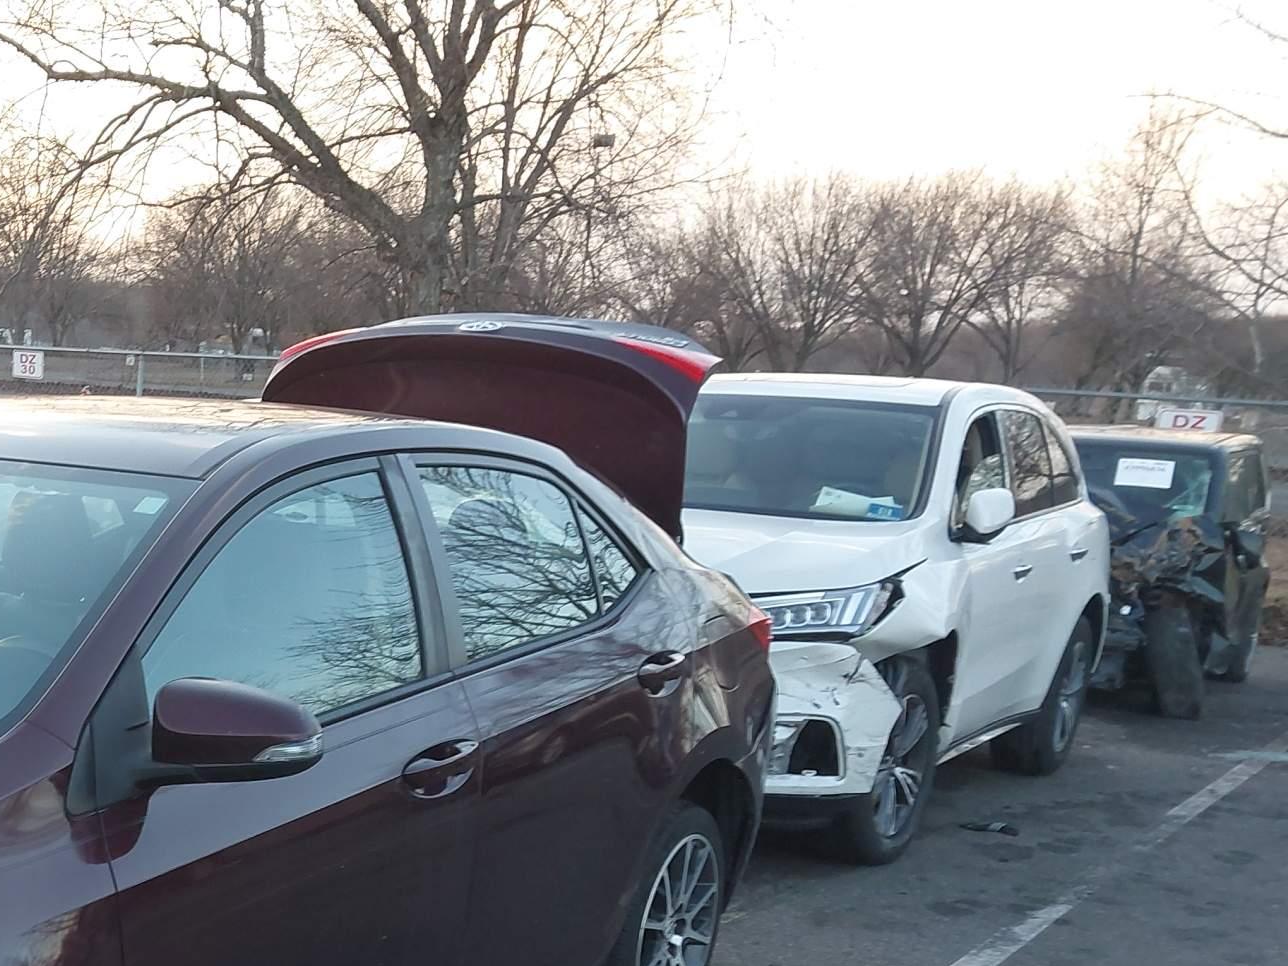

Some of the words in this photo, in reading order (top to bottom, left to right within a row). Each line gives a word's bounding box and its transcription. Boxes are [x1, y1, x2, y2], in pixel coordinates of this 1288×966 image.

[20, 353, 36, 364] DZ
[20, 364, 36, 375] 30
[1172, 415, 1207, 430] DZ
